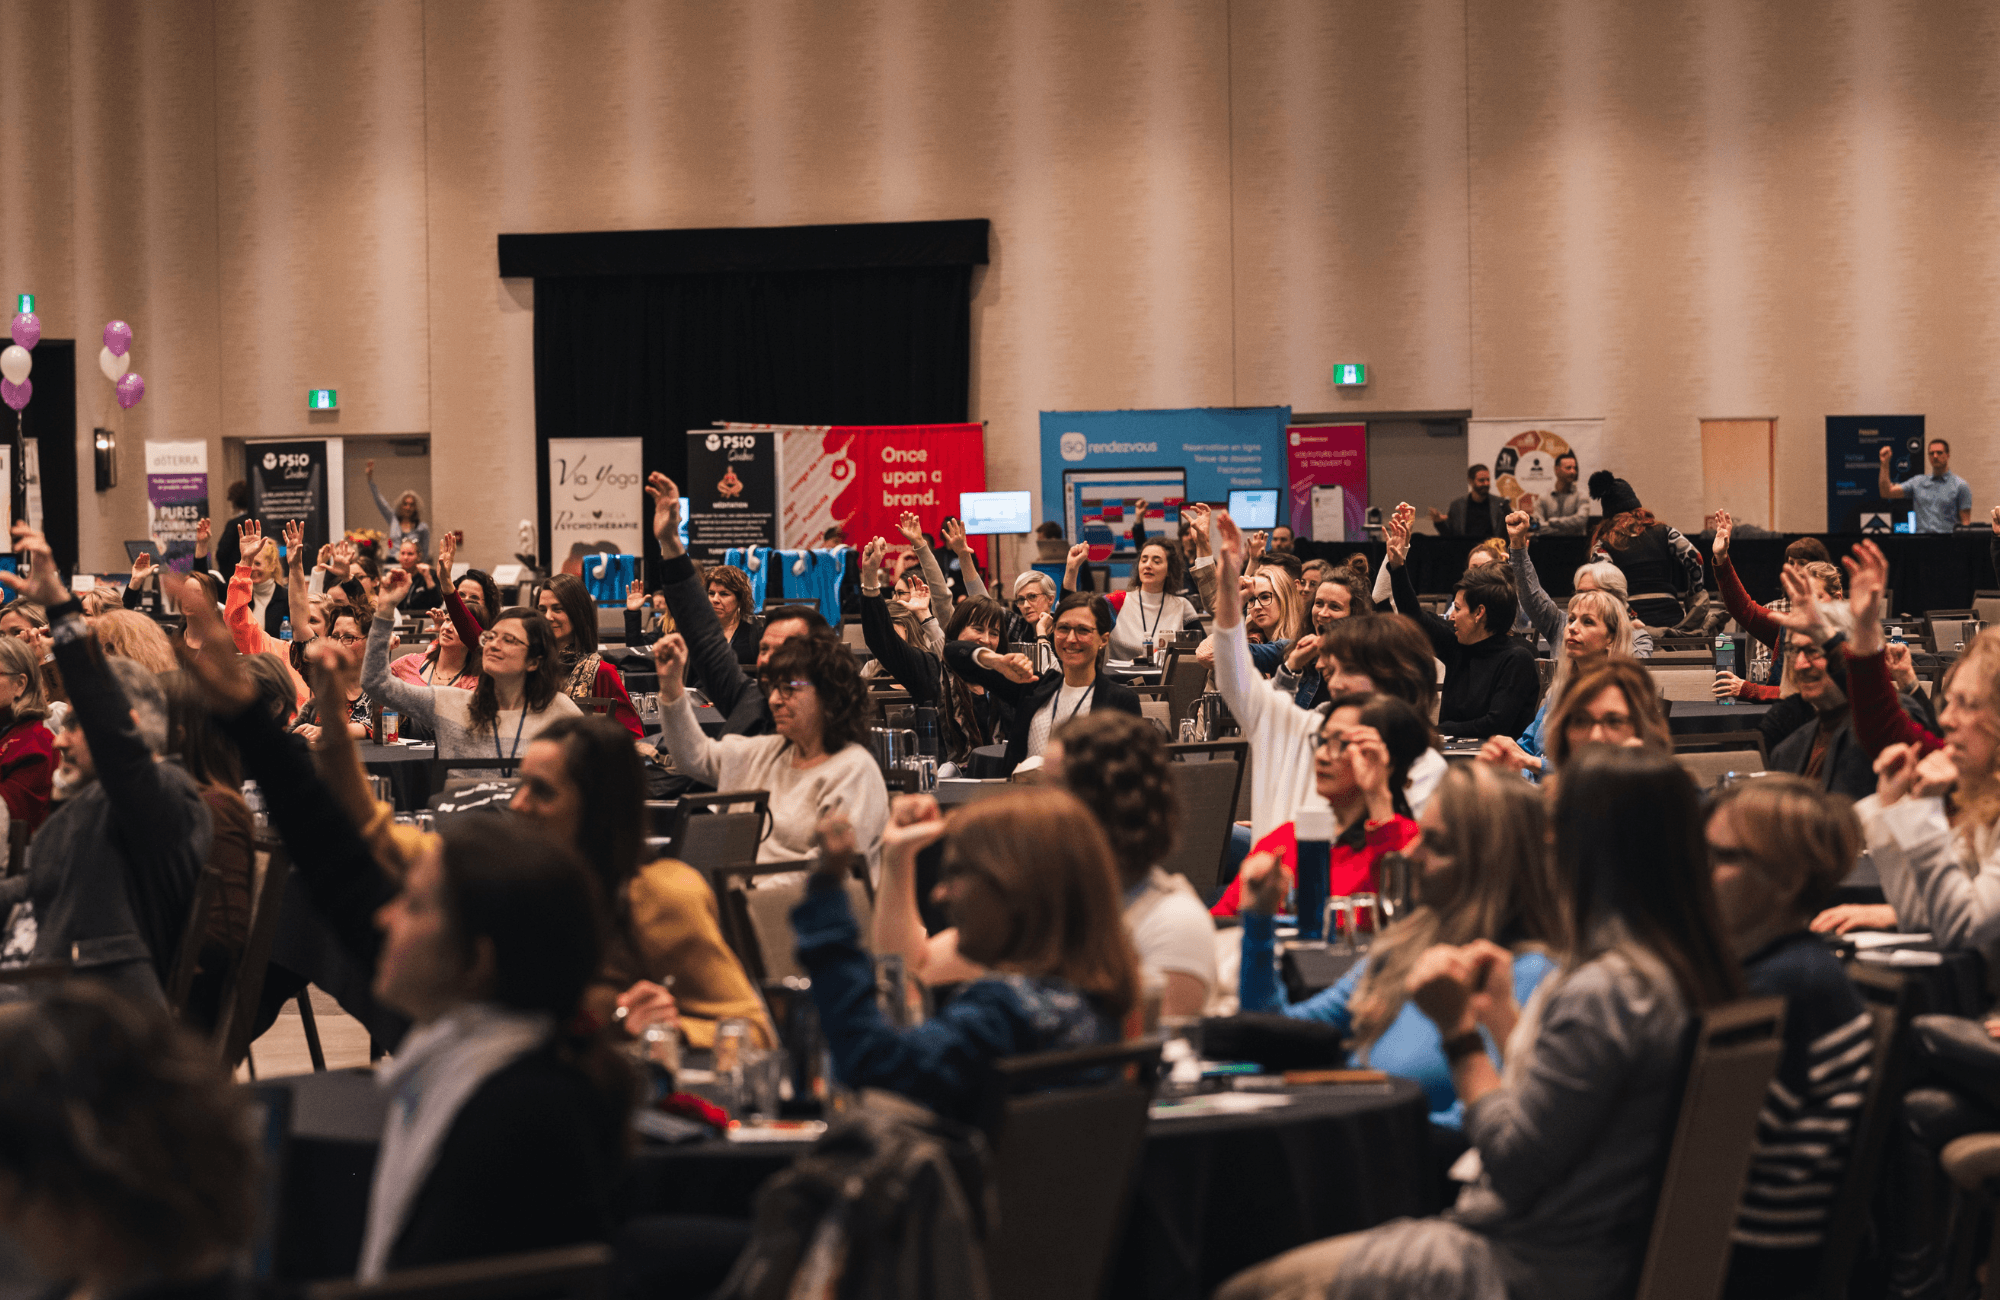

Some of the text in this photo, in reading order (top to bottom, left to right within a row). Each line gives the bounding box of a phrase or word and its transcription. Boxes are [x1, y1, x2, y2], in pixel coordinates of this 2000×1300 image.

[881, 446, 928, 463] Once
[1087, 440, 1158, 453] rendezvous
[573, 464, 639, 502] Yoga
[882, 469, 942, 488] upon a
[883, 488, 940, 507] brand.
[160, 506, 199, 520] PURES
